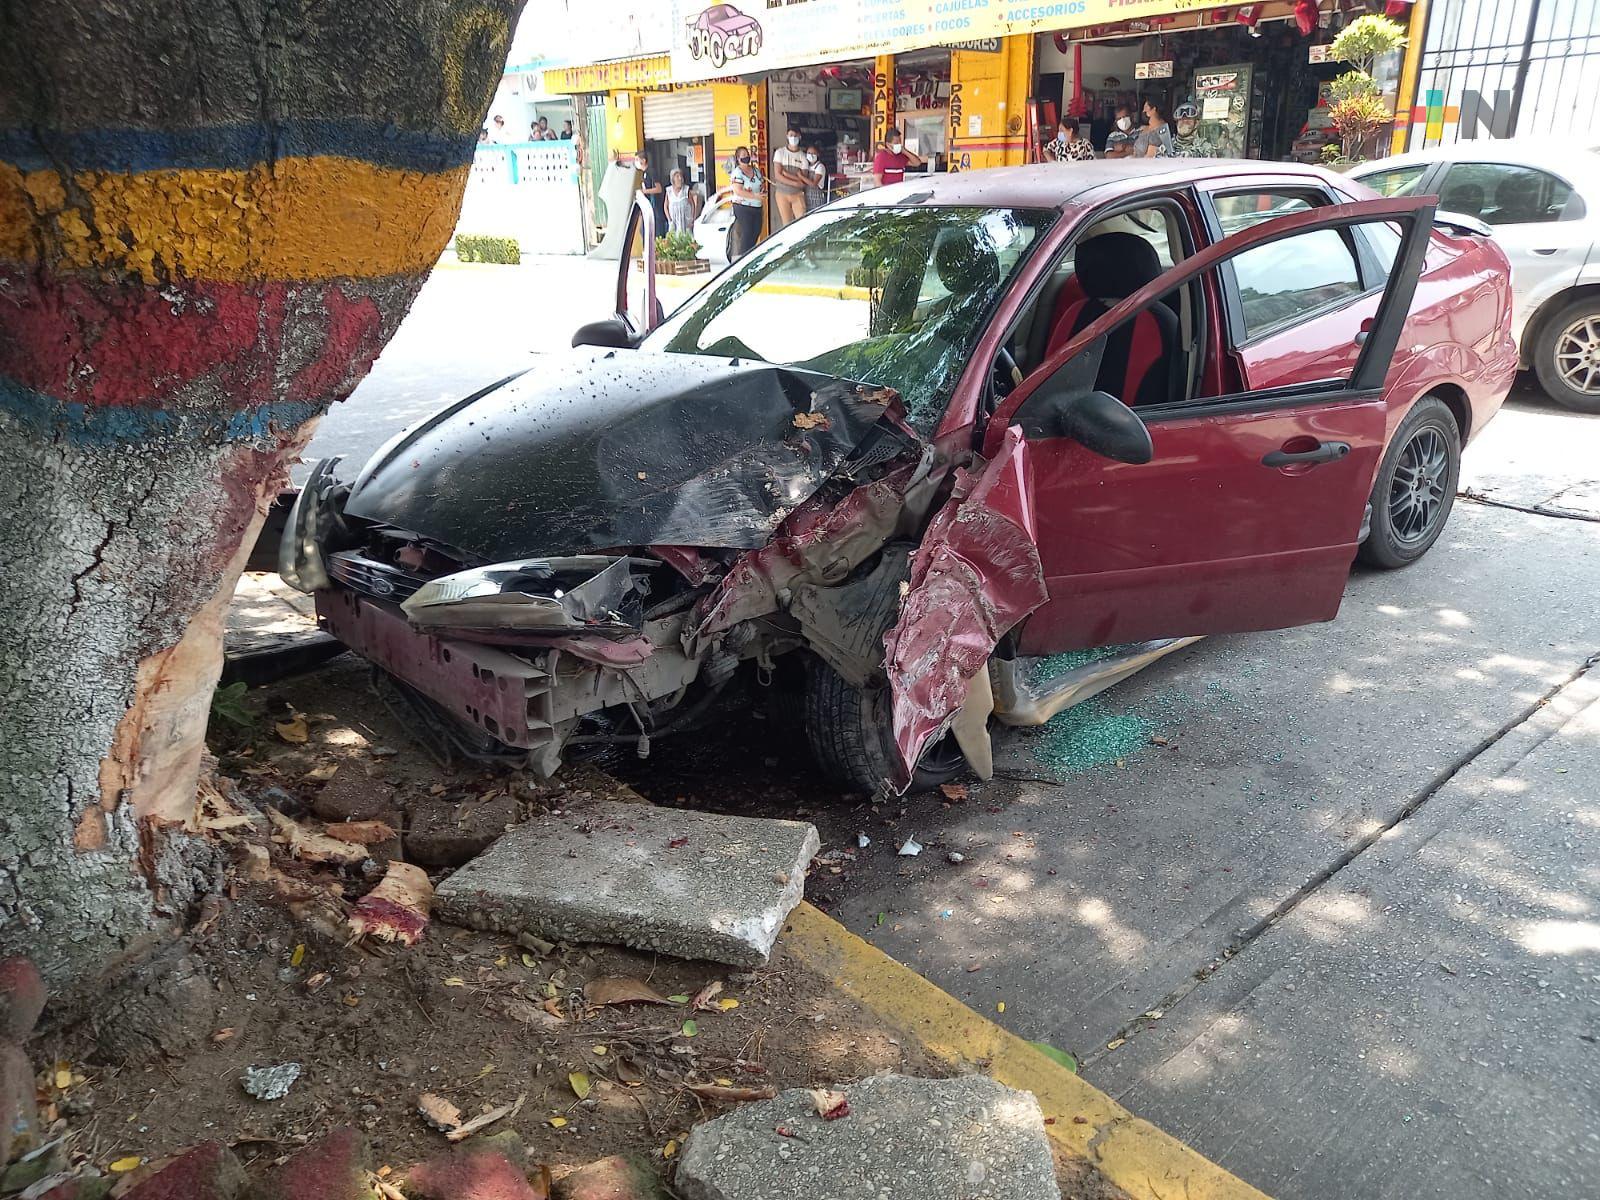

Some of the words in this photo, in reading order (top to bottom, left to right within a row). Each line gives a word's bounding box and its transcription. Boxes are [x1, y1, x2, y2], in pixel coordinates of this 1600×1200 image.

[1007, 1, 1086, 21] ACCESORIOS
[935, 16, 971, 31] FOCOS
[949, 84, 963, 173] PARRILLA
